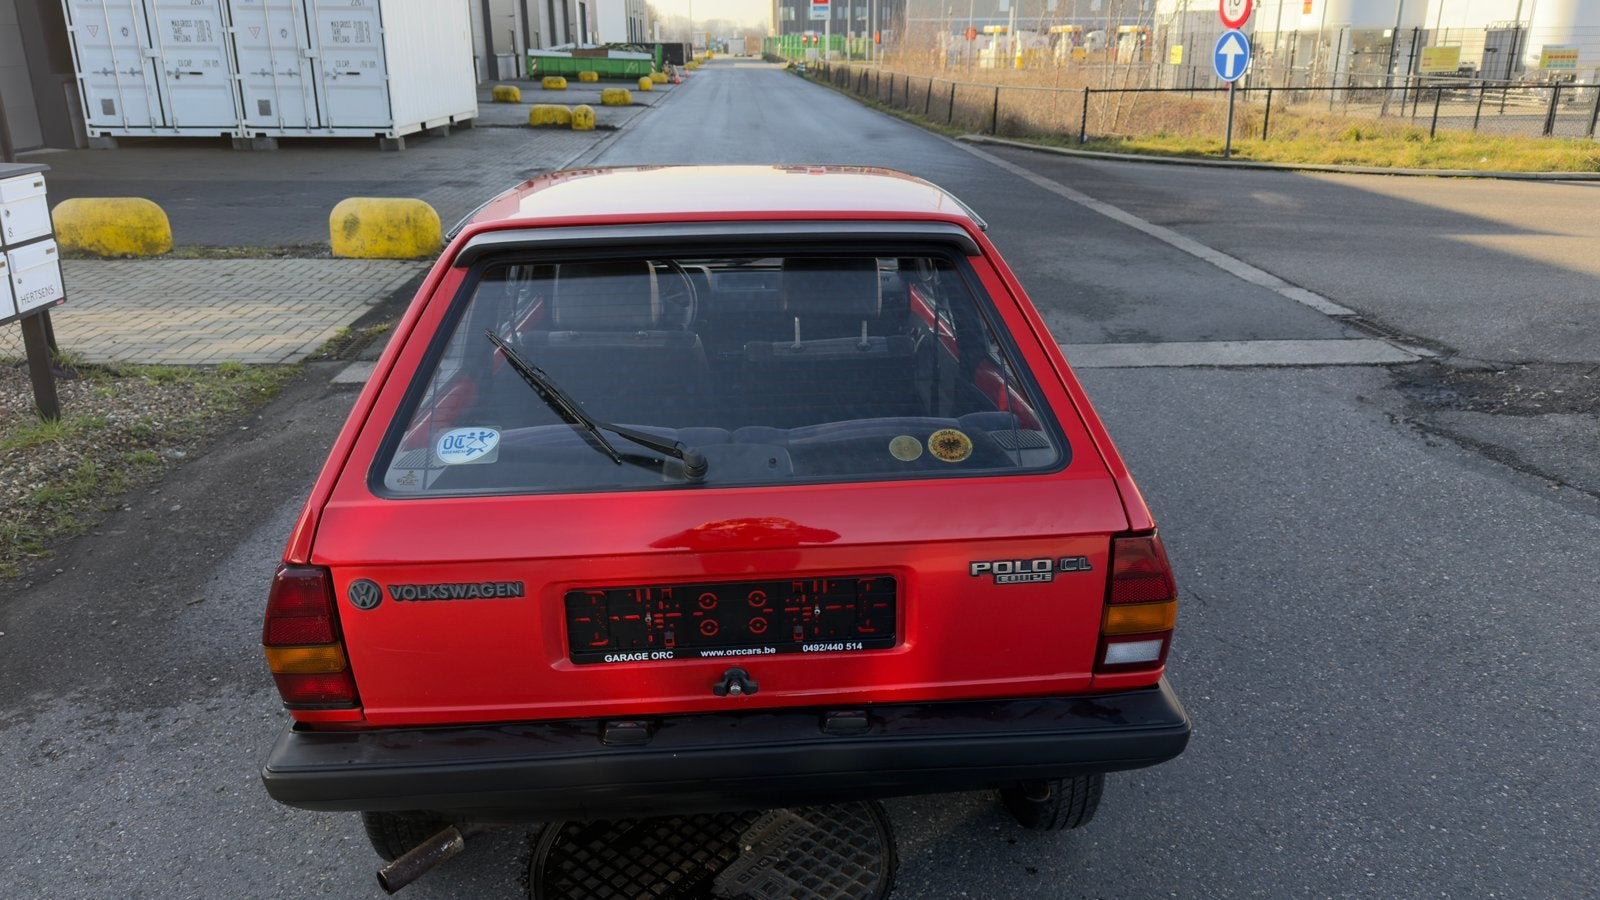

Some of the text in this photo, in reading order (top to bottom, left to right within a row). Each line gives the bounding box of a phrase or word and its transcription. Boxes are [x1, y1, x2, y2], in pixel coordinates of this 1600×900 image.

[21, 286, 54, 304] HERTSENS
[971, 557, 1092, 575] POLO CL
[389, 582, 523, 601] VOLKSWAGEN
[700, 645, 777, 658] www.orccars.be
[802, 641, 863, 653] 0492/440 514
[604, 651, 674, 663] GARAGE ORC
